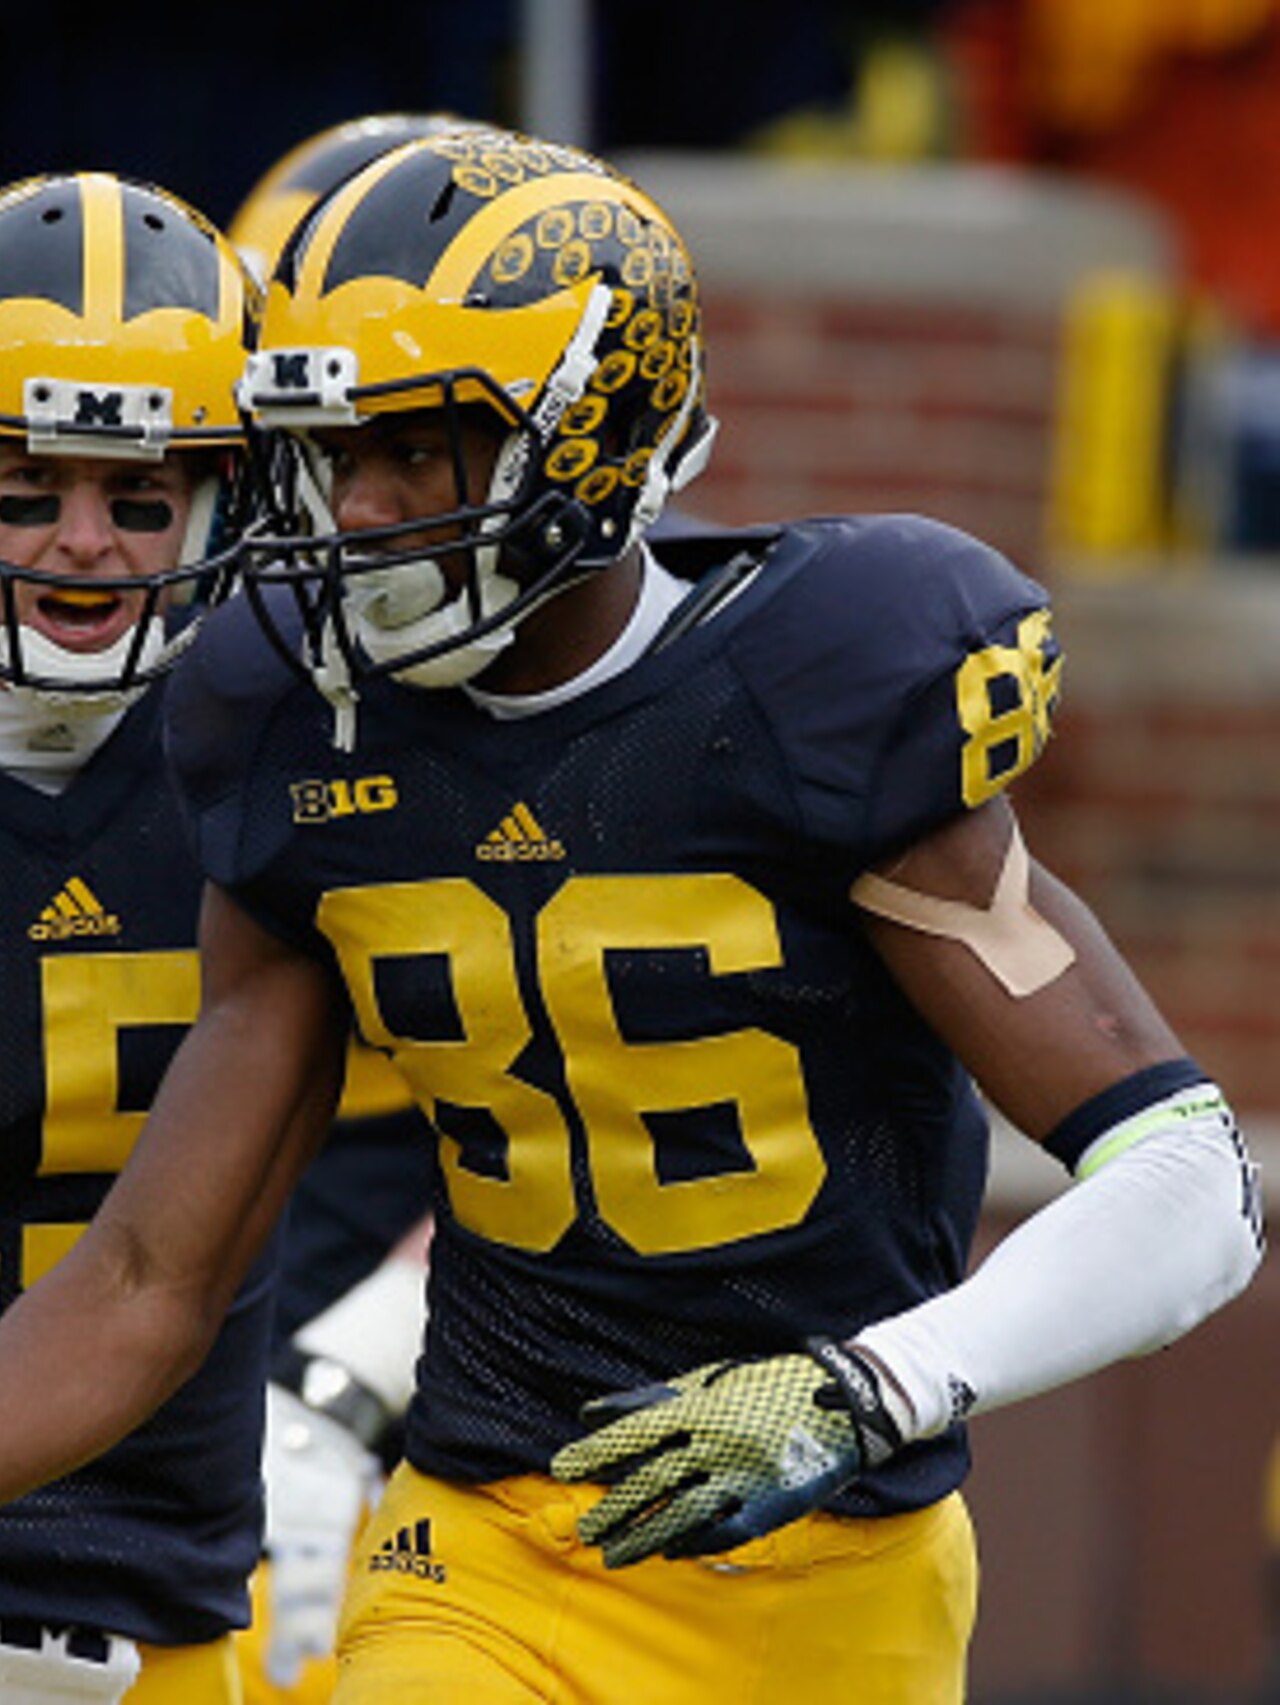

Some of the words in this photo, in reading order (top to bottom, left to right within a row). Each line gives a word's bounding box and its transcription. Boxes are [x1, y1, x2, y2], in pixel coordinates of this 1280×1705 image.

[75, 391, 124, 426] M
[475, 840, 567, 861] adidas
[316, 872, 828, 1256] 86
